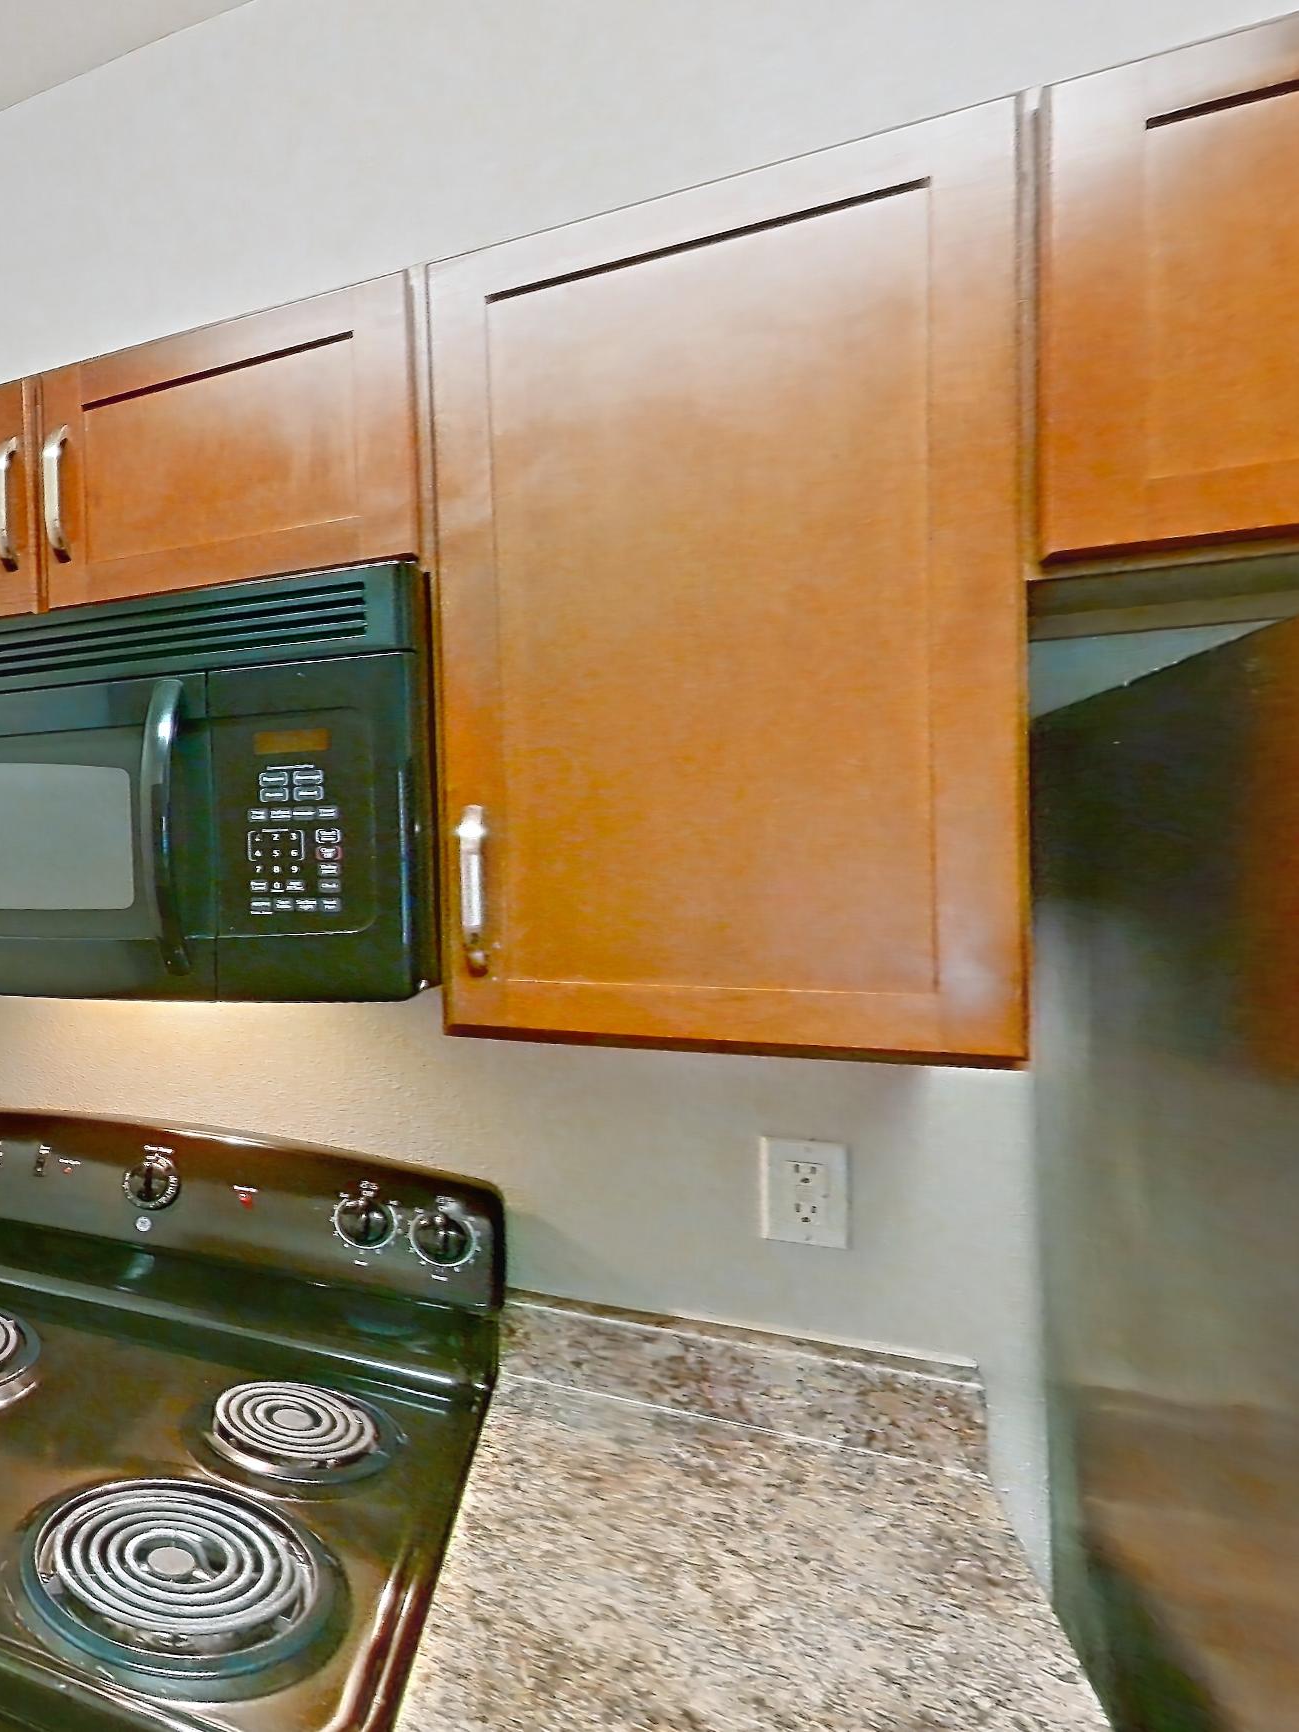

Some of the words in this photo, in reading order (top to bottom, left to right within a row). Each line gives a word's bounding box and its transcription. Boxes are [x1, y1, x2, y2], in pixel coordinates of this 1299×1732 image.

[272, 833, 280, 841] 2
[290, 832, 298, 841] 3
[272, 849, 280, 857] 5
[290, 849, 298, 857] 6
[273, 865, 280, 873] 8
[291, 865, 298, 873] 9
